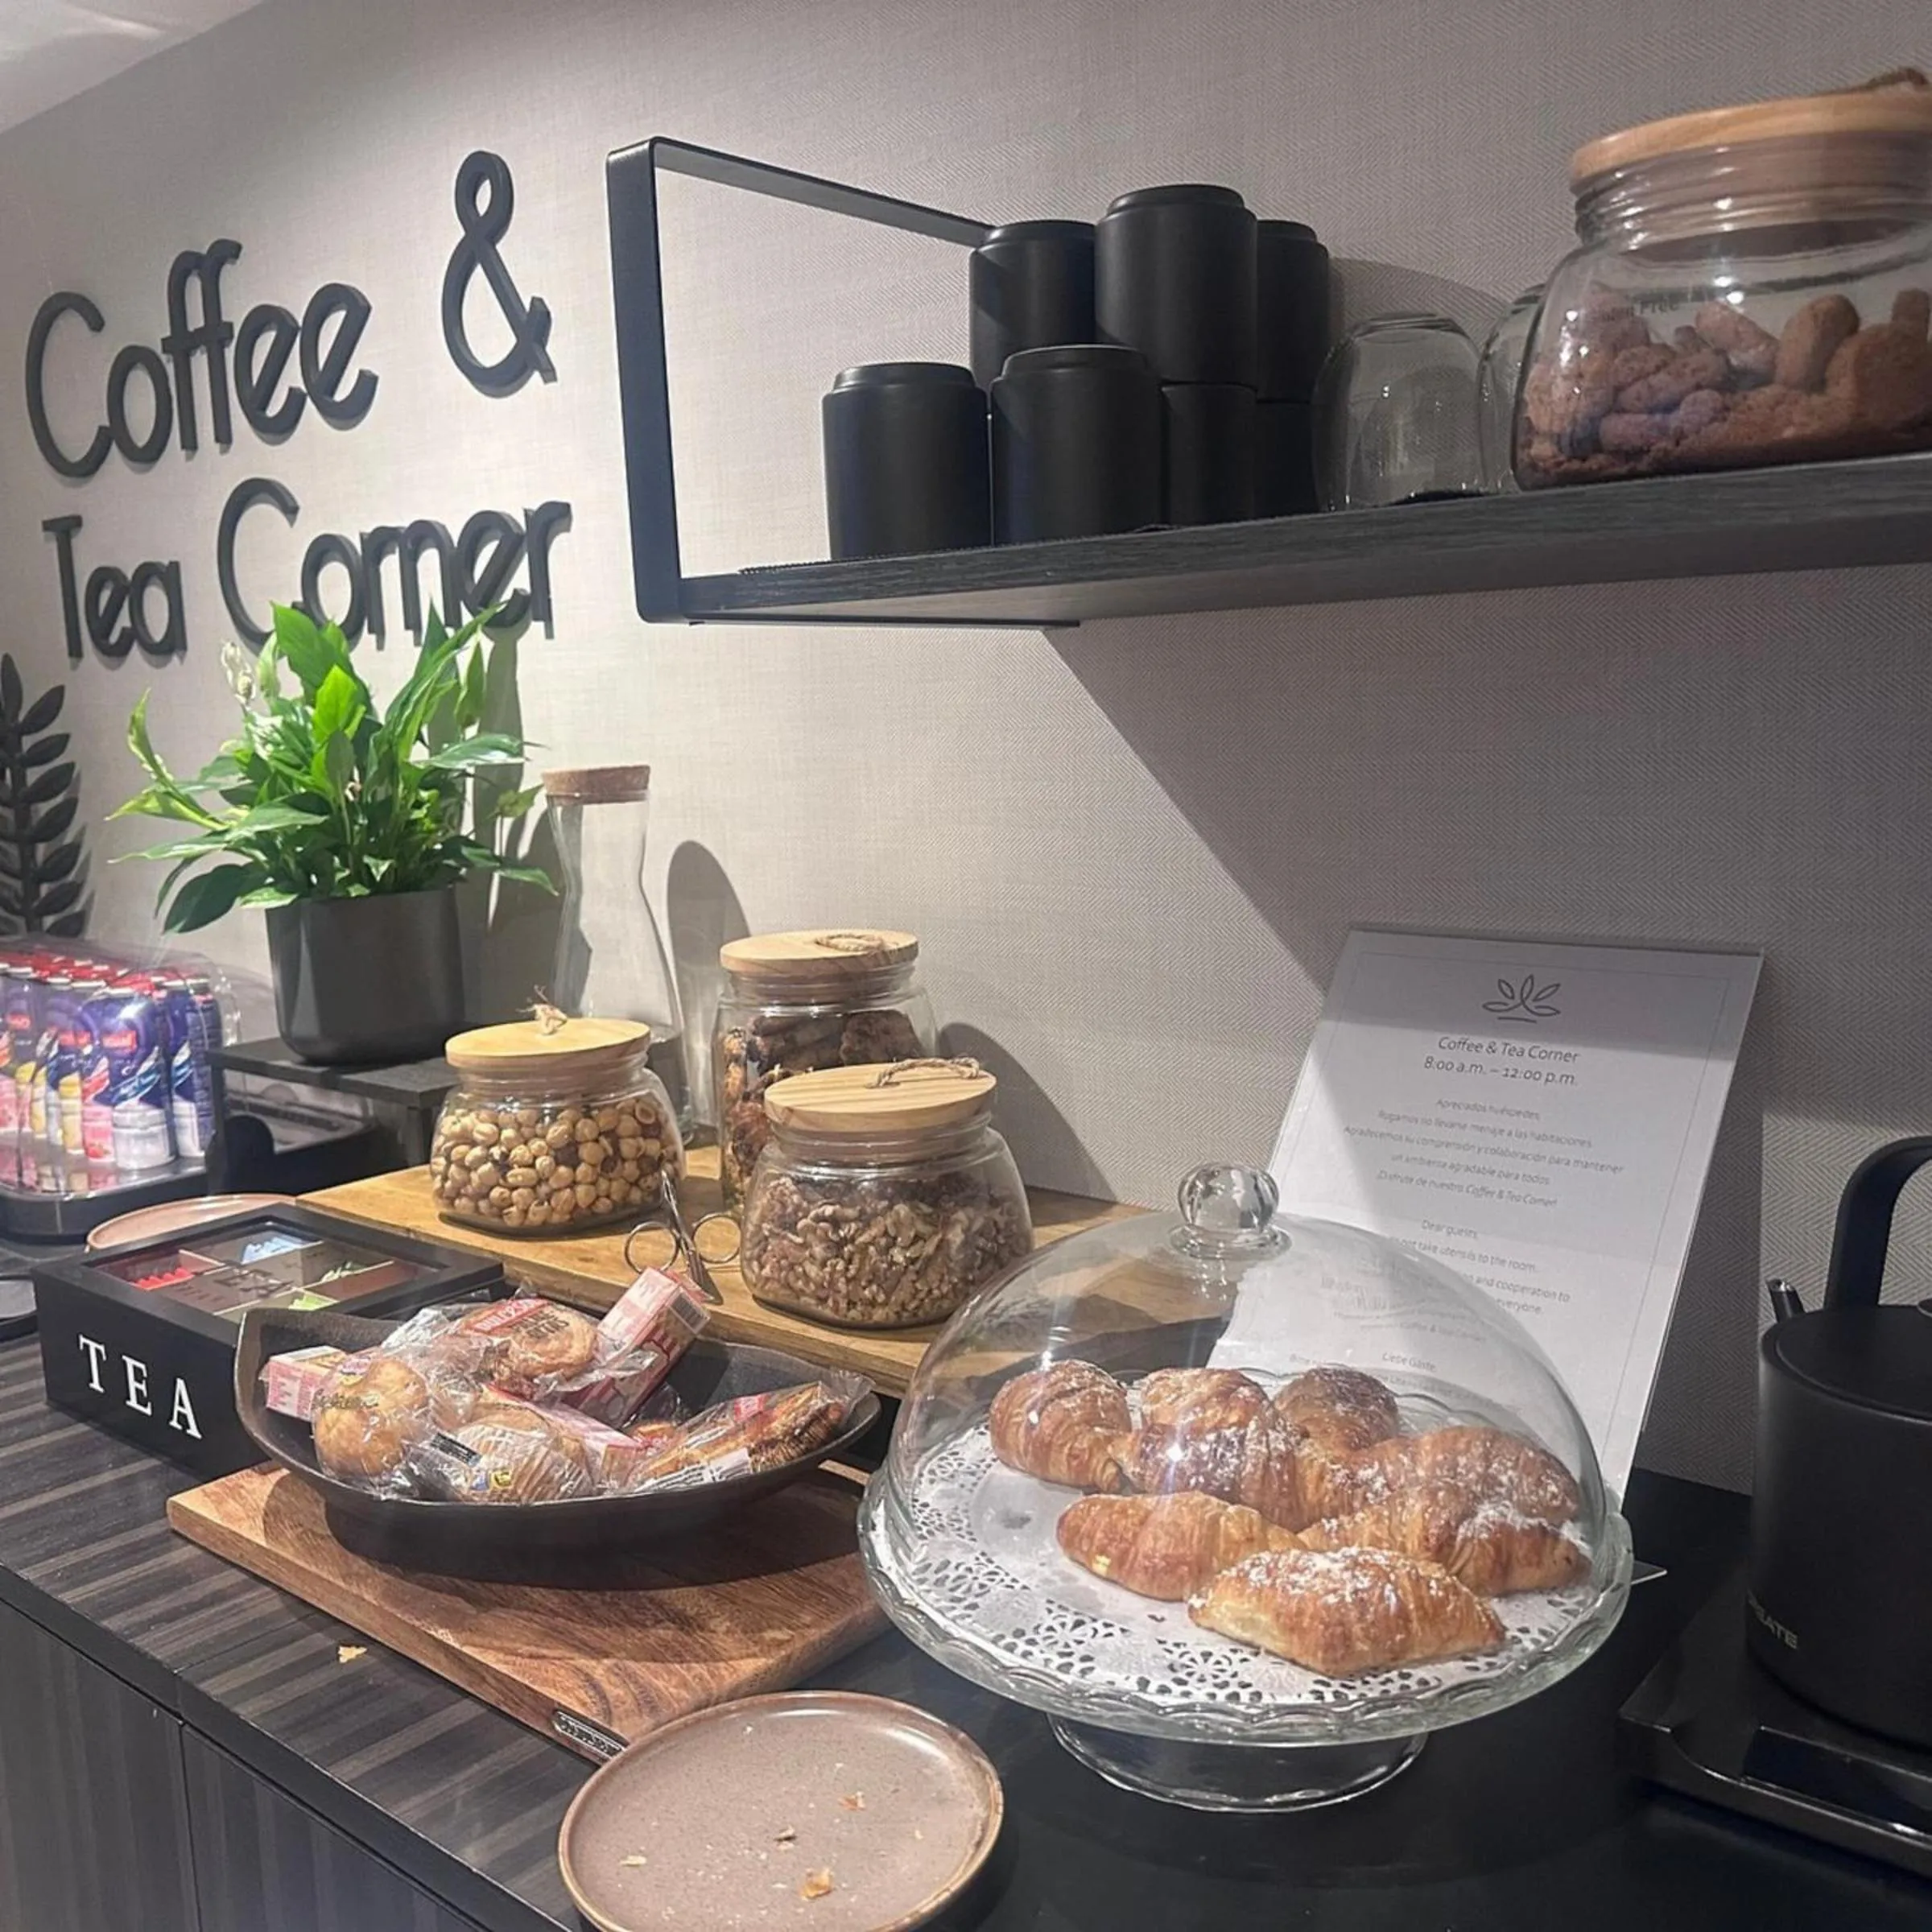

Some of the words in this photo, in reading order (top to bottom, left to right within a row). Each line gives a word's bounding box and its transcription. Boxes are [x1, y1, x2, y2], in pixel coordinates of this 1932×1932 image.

[25, 239, 379, 478] Coffee
[442, 150, 557, 398] &
[42, 515, 188, 659] Tea
[217, 477, 572, 656] Corner
[1438, 1036, 1484, 1054] Coffee
[1485, 1041, 1497, 1055] &
[1501, 1042, 1525, 1058] Tea
[1528, 1046, 1581, 1063] Corner
[1501, 1067, 1542, 1082] 12:00
[1548, 1155, 1571, 1167] para
[1496, 1170, 1520, 1182] para
[1465, 1184, 1496, 1199] Coffee
[1506, 1190, 1522, 1202] Tea
[1422, 1219, 1446, 1232] Dear
[1418, 1241, 1439, 1254] take
[1478, 1252, 1489, 1264] to
[1490, 1254, 1507, 1268] the
[1476, 1274, 1494, 1286] and
[1496, 1278, 1557, 1300] cooperation
[1558, 1292, 1571, 1302] to
[78, 1333, 204, 1440] TEA
